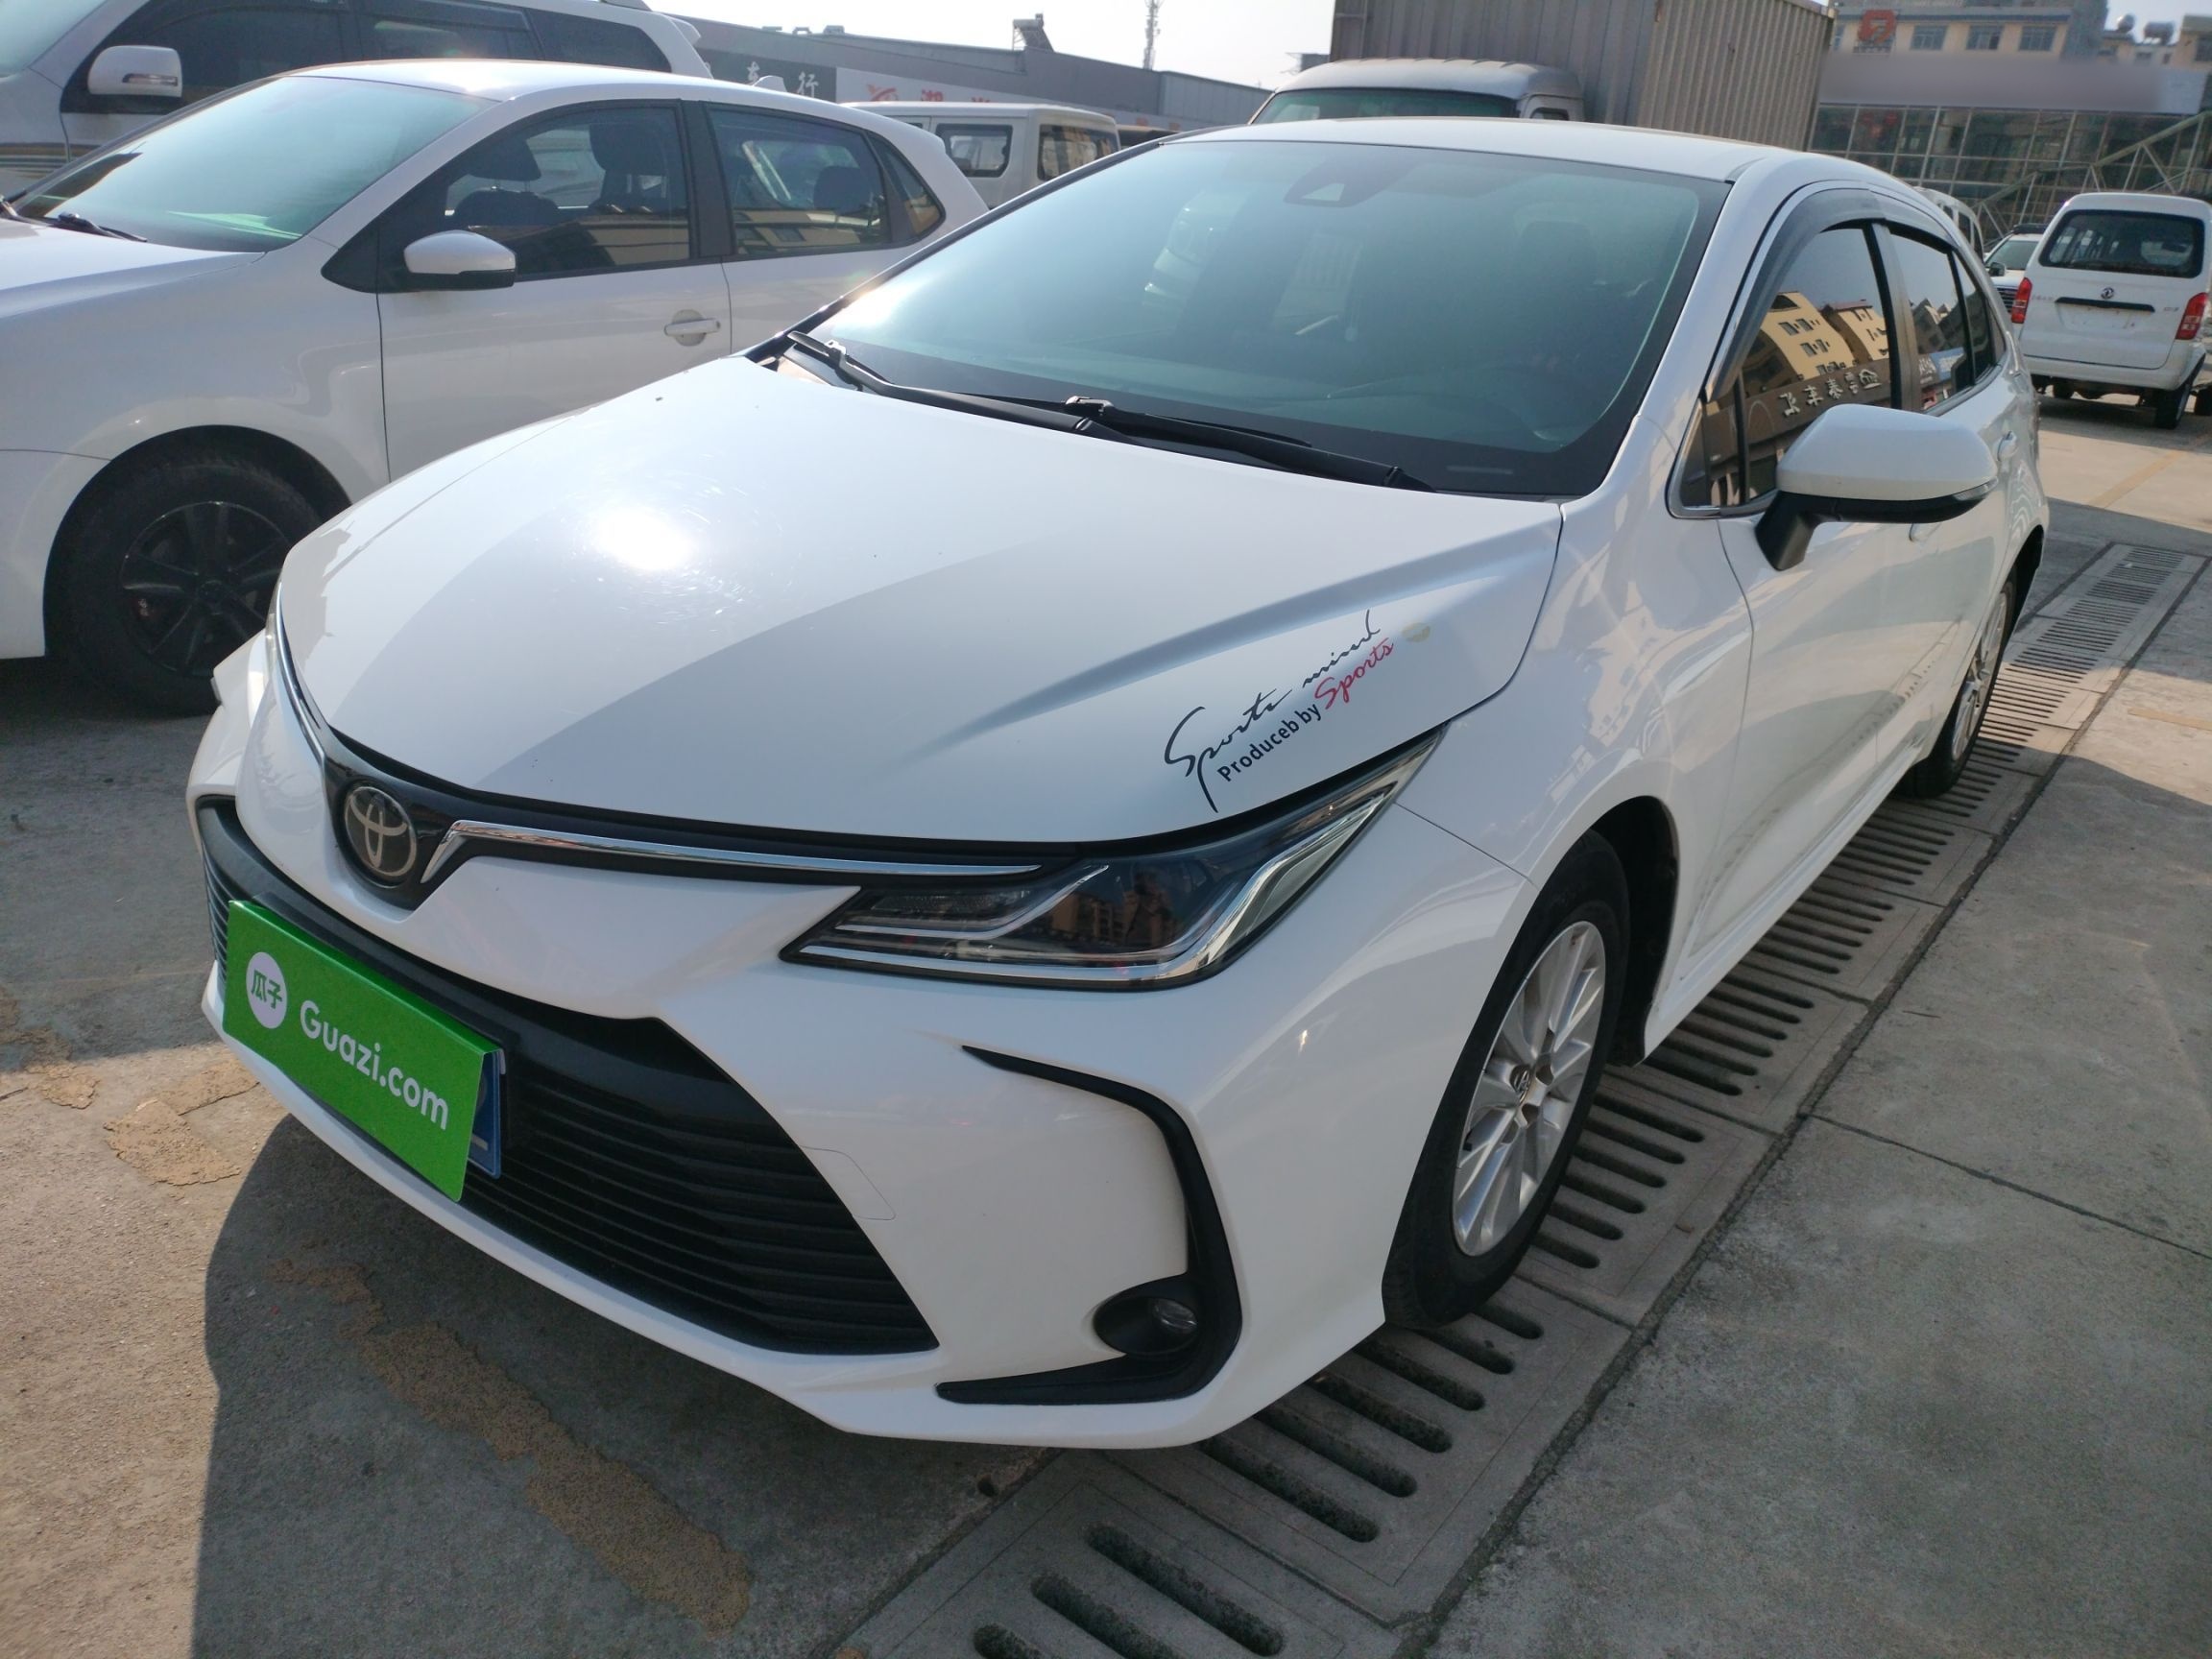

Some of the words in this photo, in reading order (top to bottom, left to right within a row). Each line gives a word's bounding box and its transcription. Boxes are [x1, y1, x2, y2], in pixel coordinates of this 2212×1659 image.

[1294, 703, 1322, 724] by
[1314, 637, 1395, 710] Sports
[252, 970, 283, 1009] 瓜子
[300, 999, 449, 1131] Guazi.com
